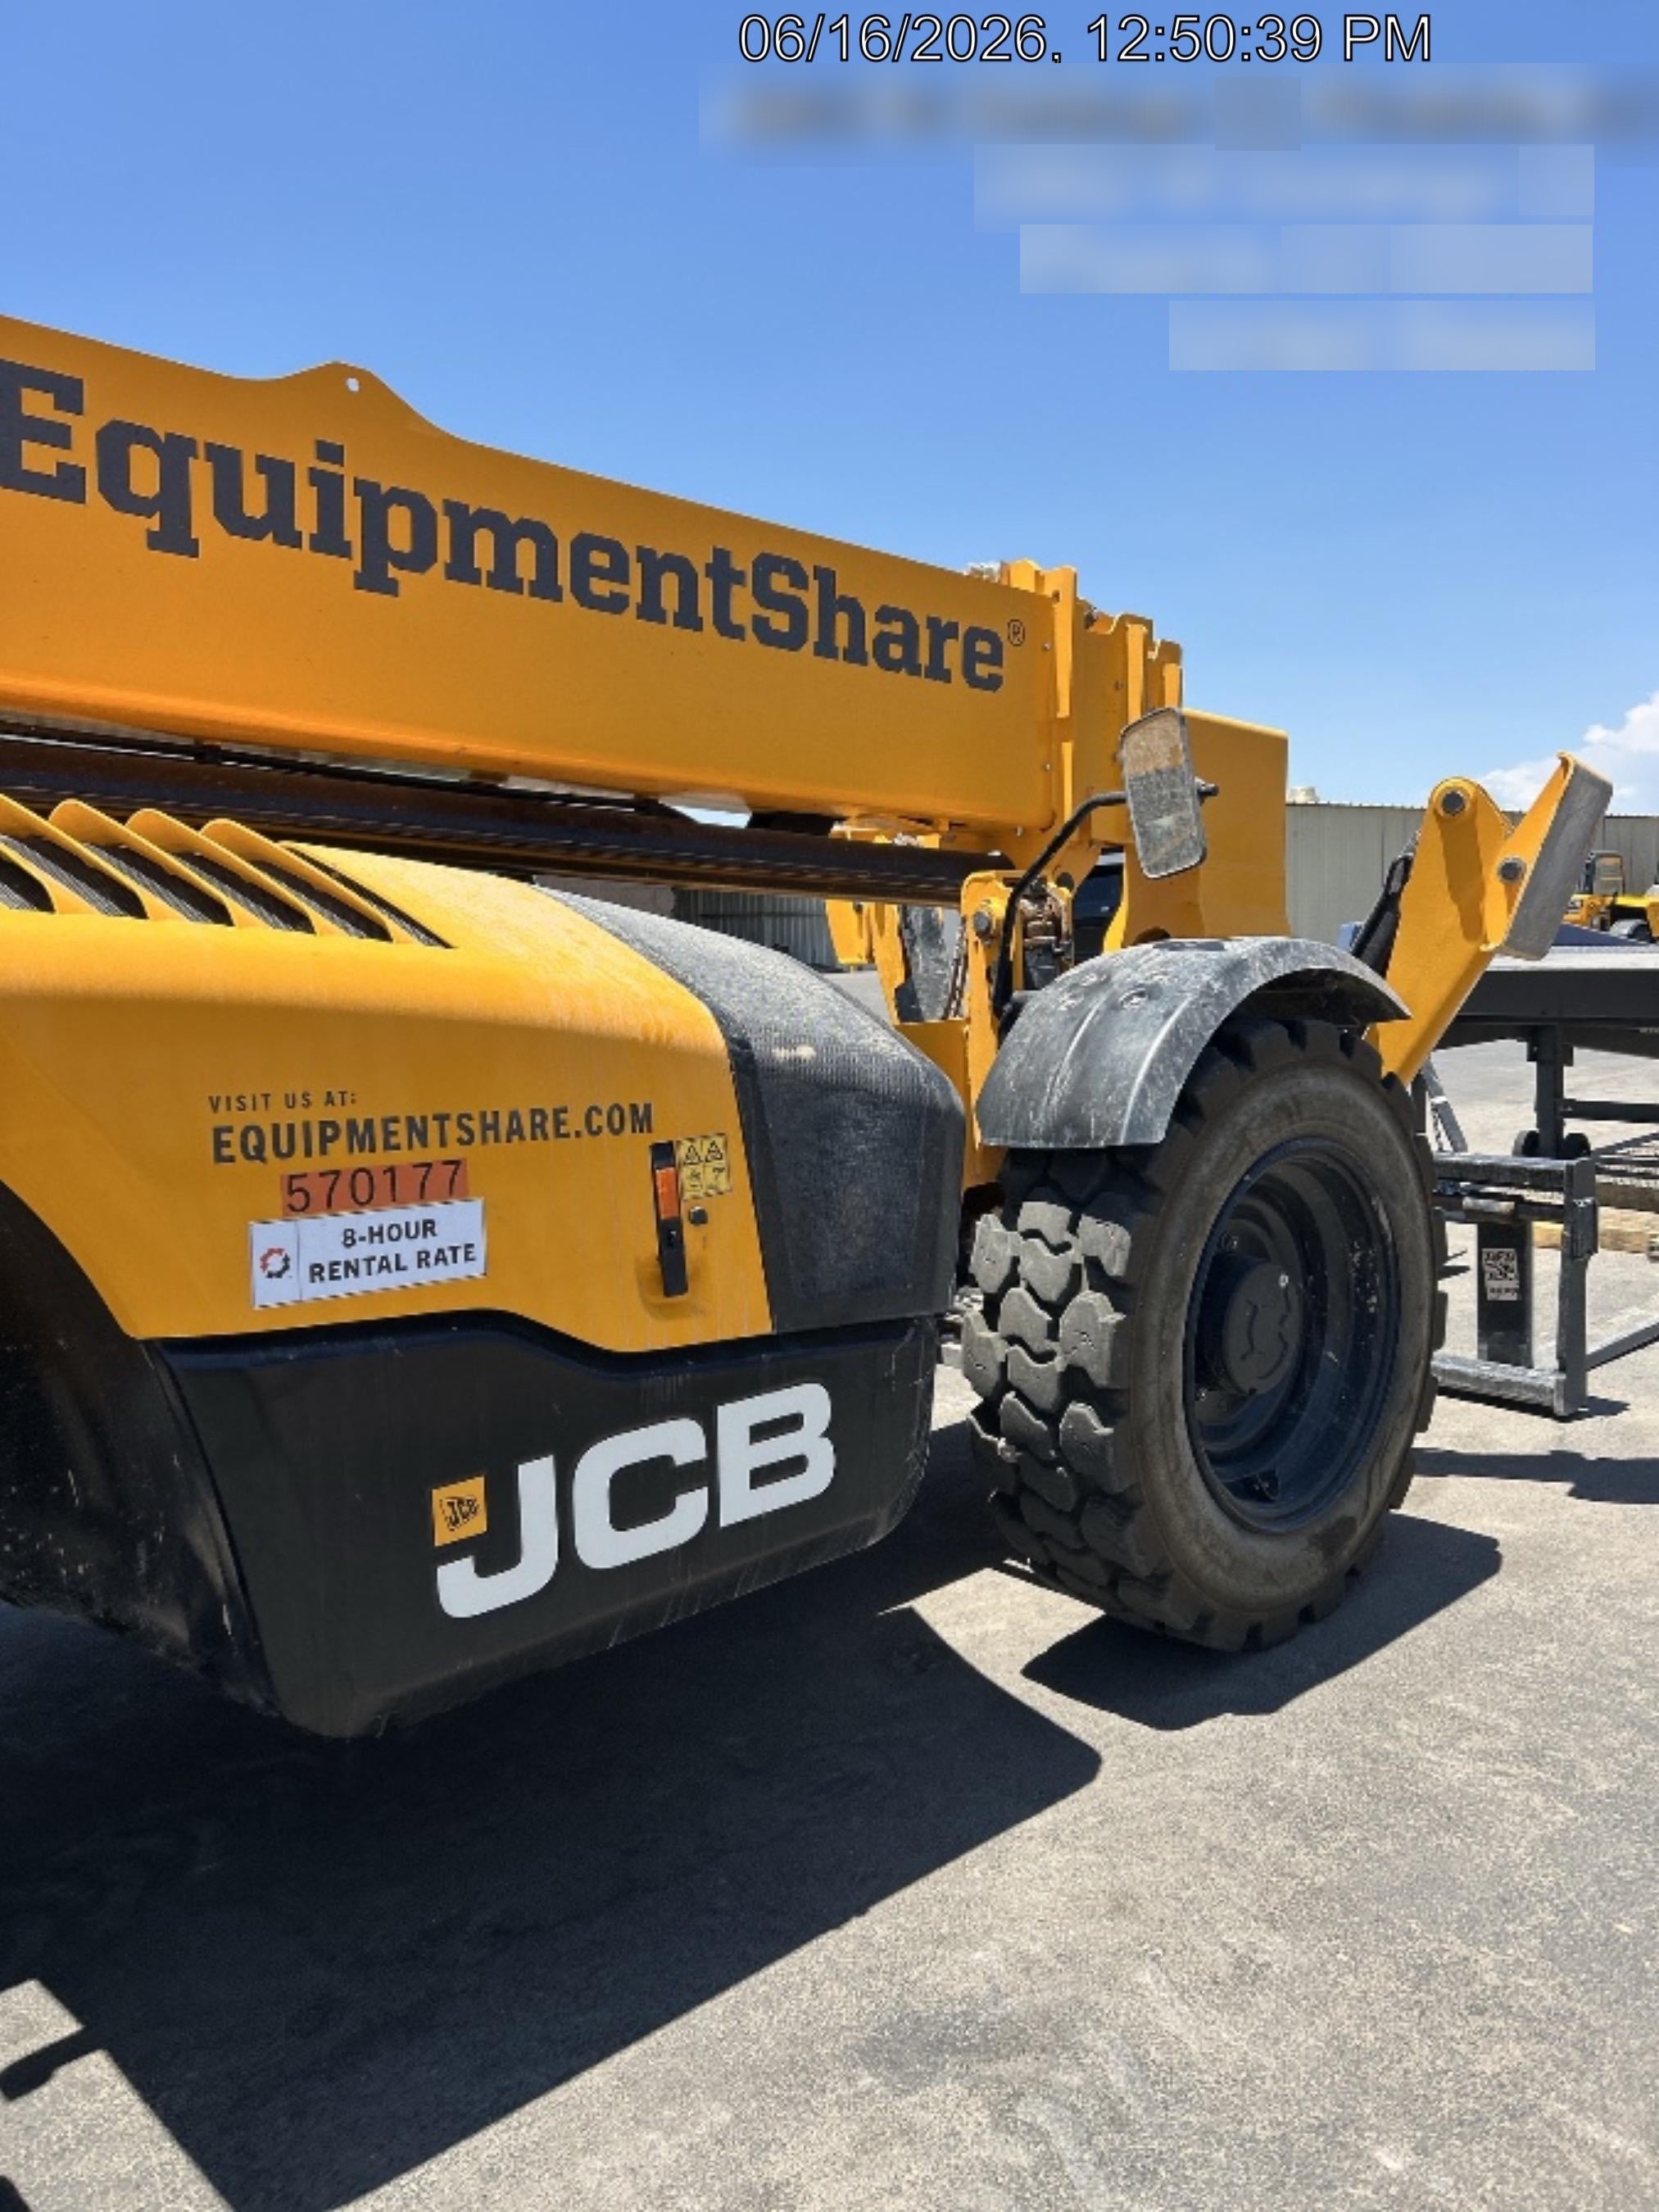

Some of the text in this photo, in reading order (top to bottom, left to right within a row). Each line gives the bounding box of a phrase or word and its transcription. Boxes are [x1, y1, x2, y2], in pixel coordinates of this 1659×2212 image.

[208, 1090, 356, 1113] VISIT US AT:
[212, 1102, 653, 1163] EQUIPMENTSHARE.COM
[288, 1159, 462, 1213] 570177
[342, 1218, 437, 1249] 8-HOUR
[308, 1243, 477, 1283] RENTAL RATE
[437, 1382, 836, 1618] JCB
